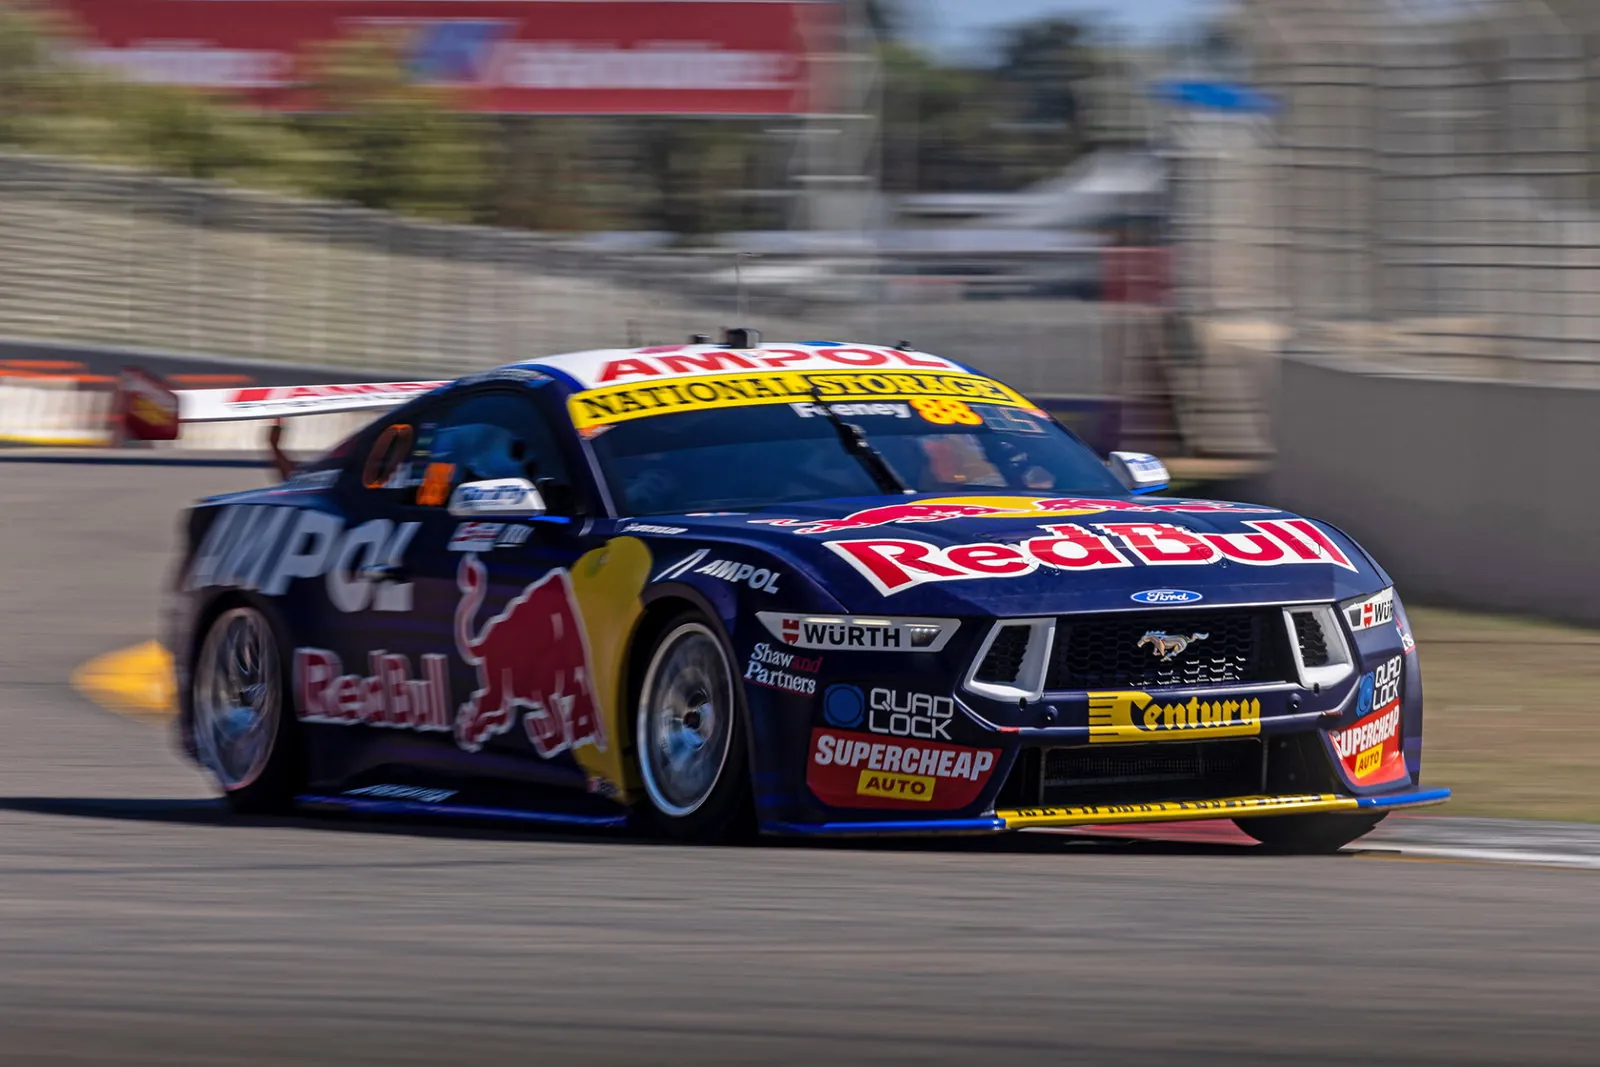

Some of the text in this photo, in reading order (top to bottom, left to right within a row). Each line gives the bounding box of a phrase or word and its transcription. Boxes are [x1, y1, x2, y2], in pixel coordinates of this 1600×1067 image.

[596, 348, 951, 383] AMPOL
[578, 375, 812, 419] NATIONAL
[809, 374, 1003, 399] STORAGE
[909, 398, 983, 426] 88
[181, 503, 423, 613] AMPOL
[694, 559, 781, 595] AMPOL
[803, 623, 901, 648] WÜRTH
[743, 660, 817, 694] Partners
[1375, 655, 1402, 686] QUAD
[869, 687, 954, 718] QUAD
[1372, 676, 1400, 711] LOCK
[868, 715, 952, 740] LOCK
[1087, 691, 1262, 743] Century
[1332, 705, 1400, 760] SUPERCHEAP
[814, 734, 994, 781] SUPERCHEAP
[1357, 751, 1380, 772] AUTO
[865, 776, 927, 796] AUTO
